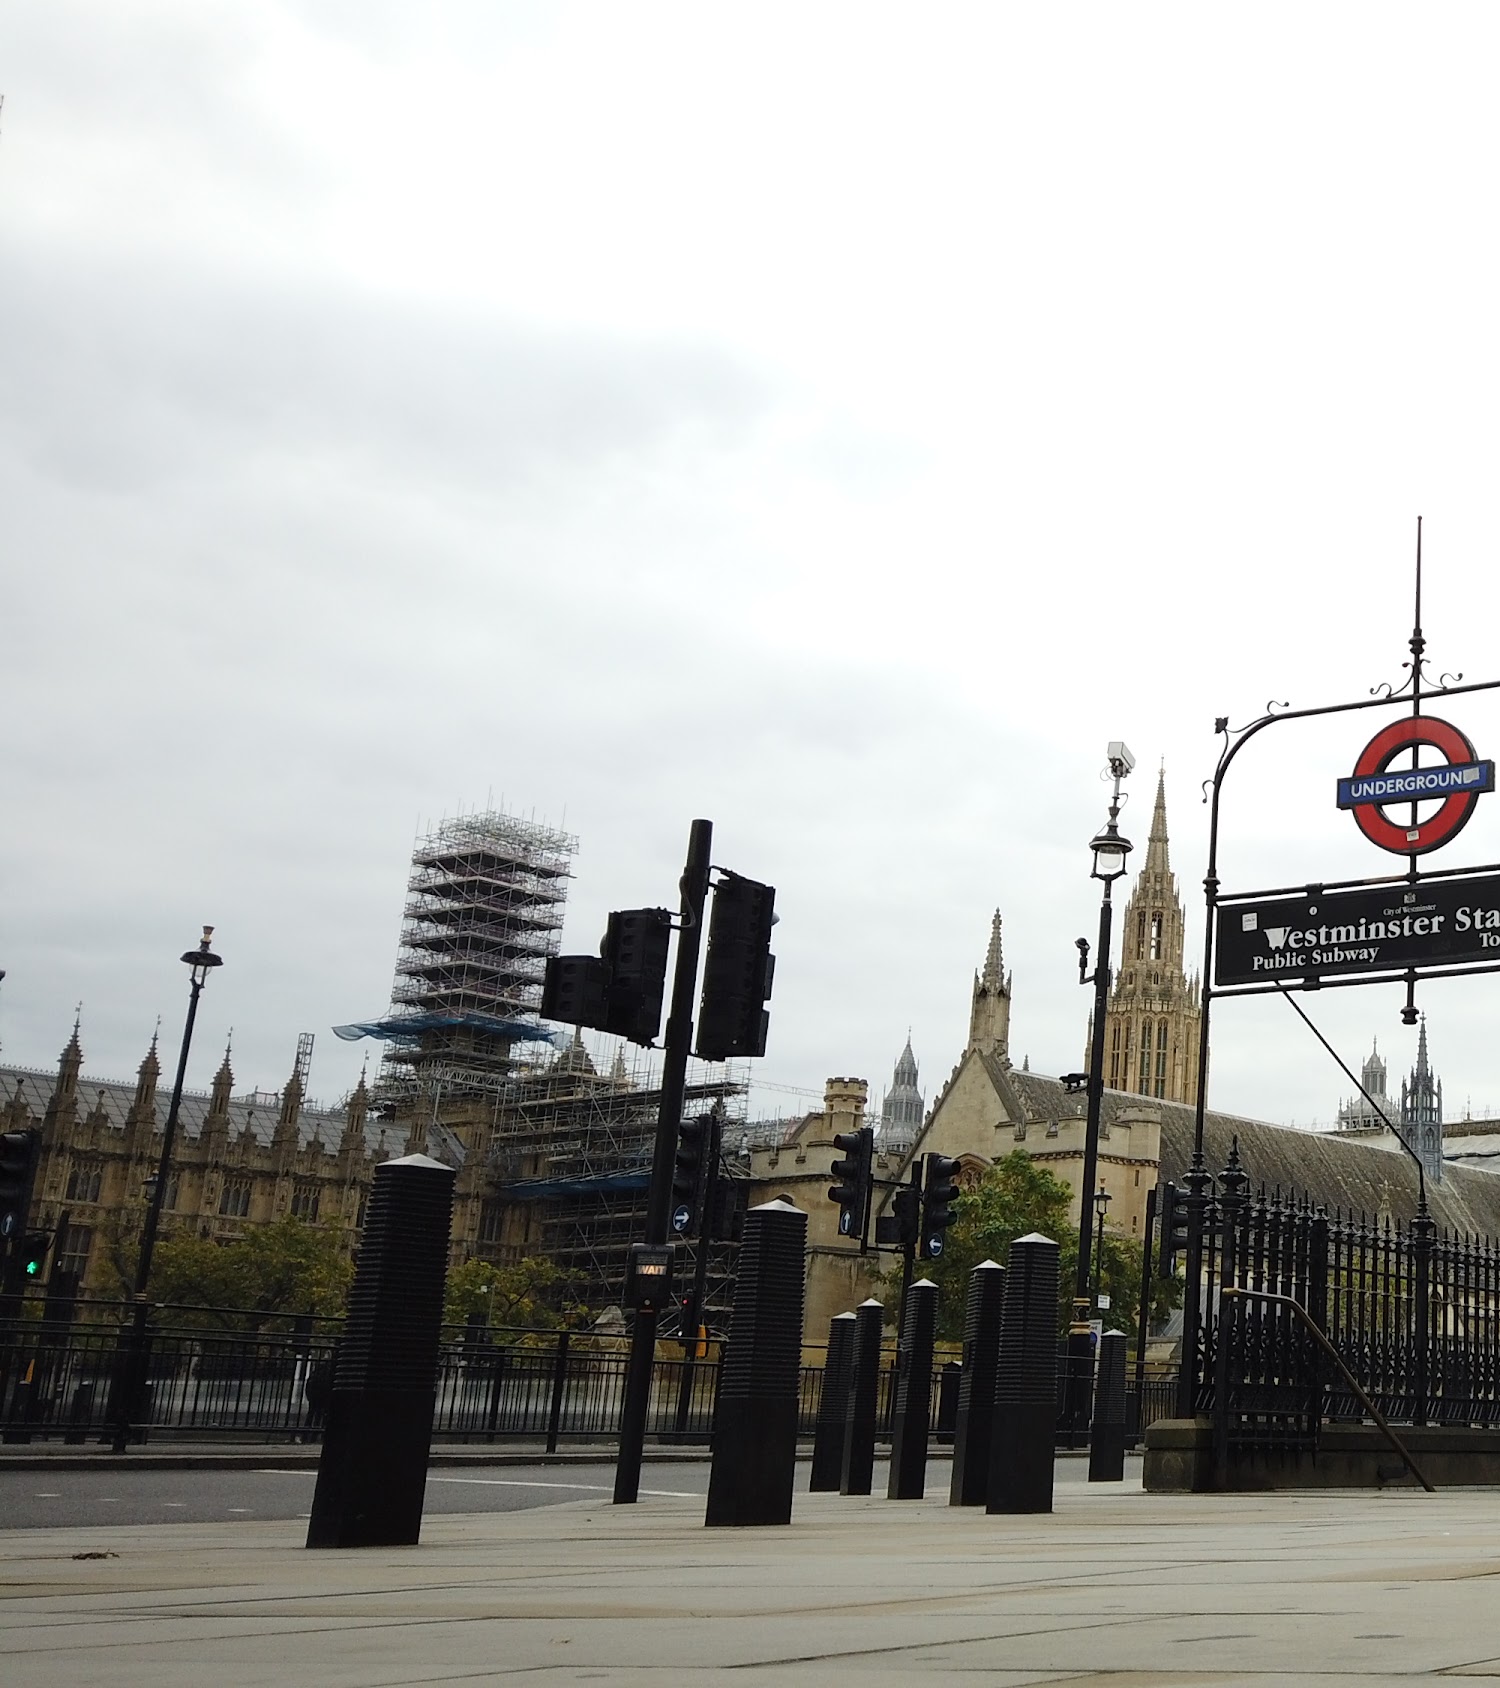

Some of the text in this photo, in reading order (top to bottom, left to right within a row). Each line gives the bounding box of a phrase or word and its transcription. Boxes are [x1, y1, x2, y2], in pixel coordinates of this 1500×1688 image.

[1351, 768, 1475, 798] UNDERGROUN
[1383, 908, 1394, 917] City
[1402, 904, 1437, 913] Westminster
[1252, 947, 1380, 971] Public Subway
[638, 1265, 666, 1275] WAIT
